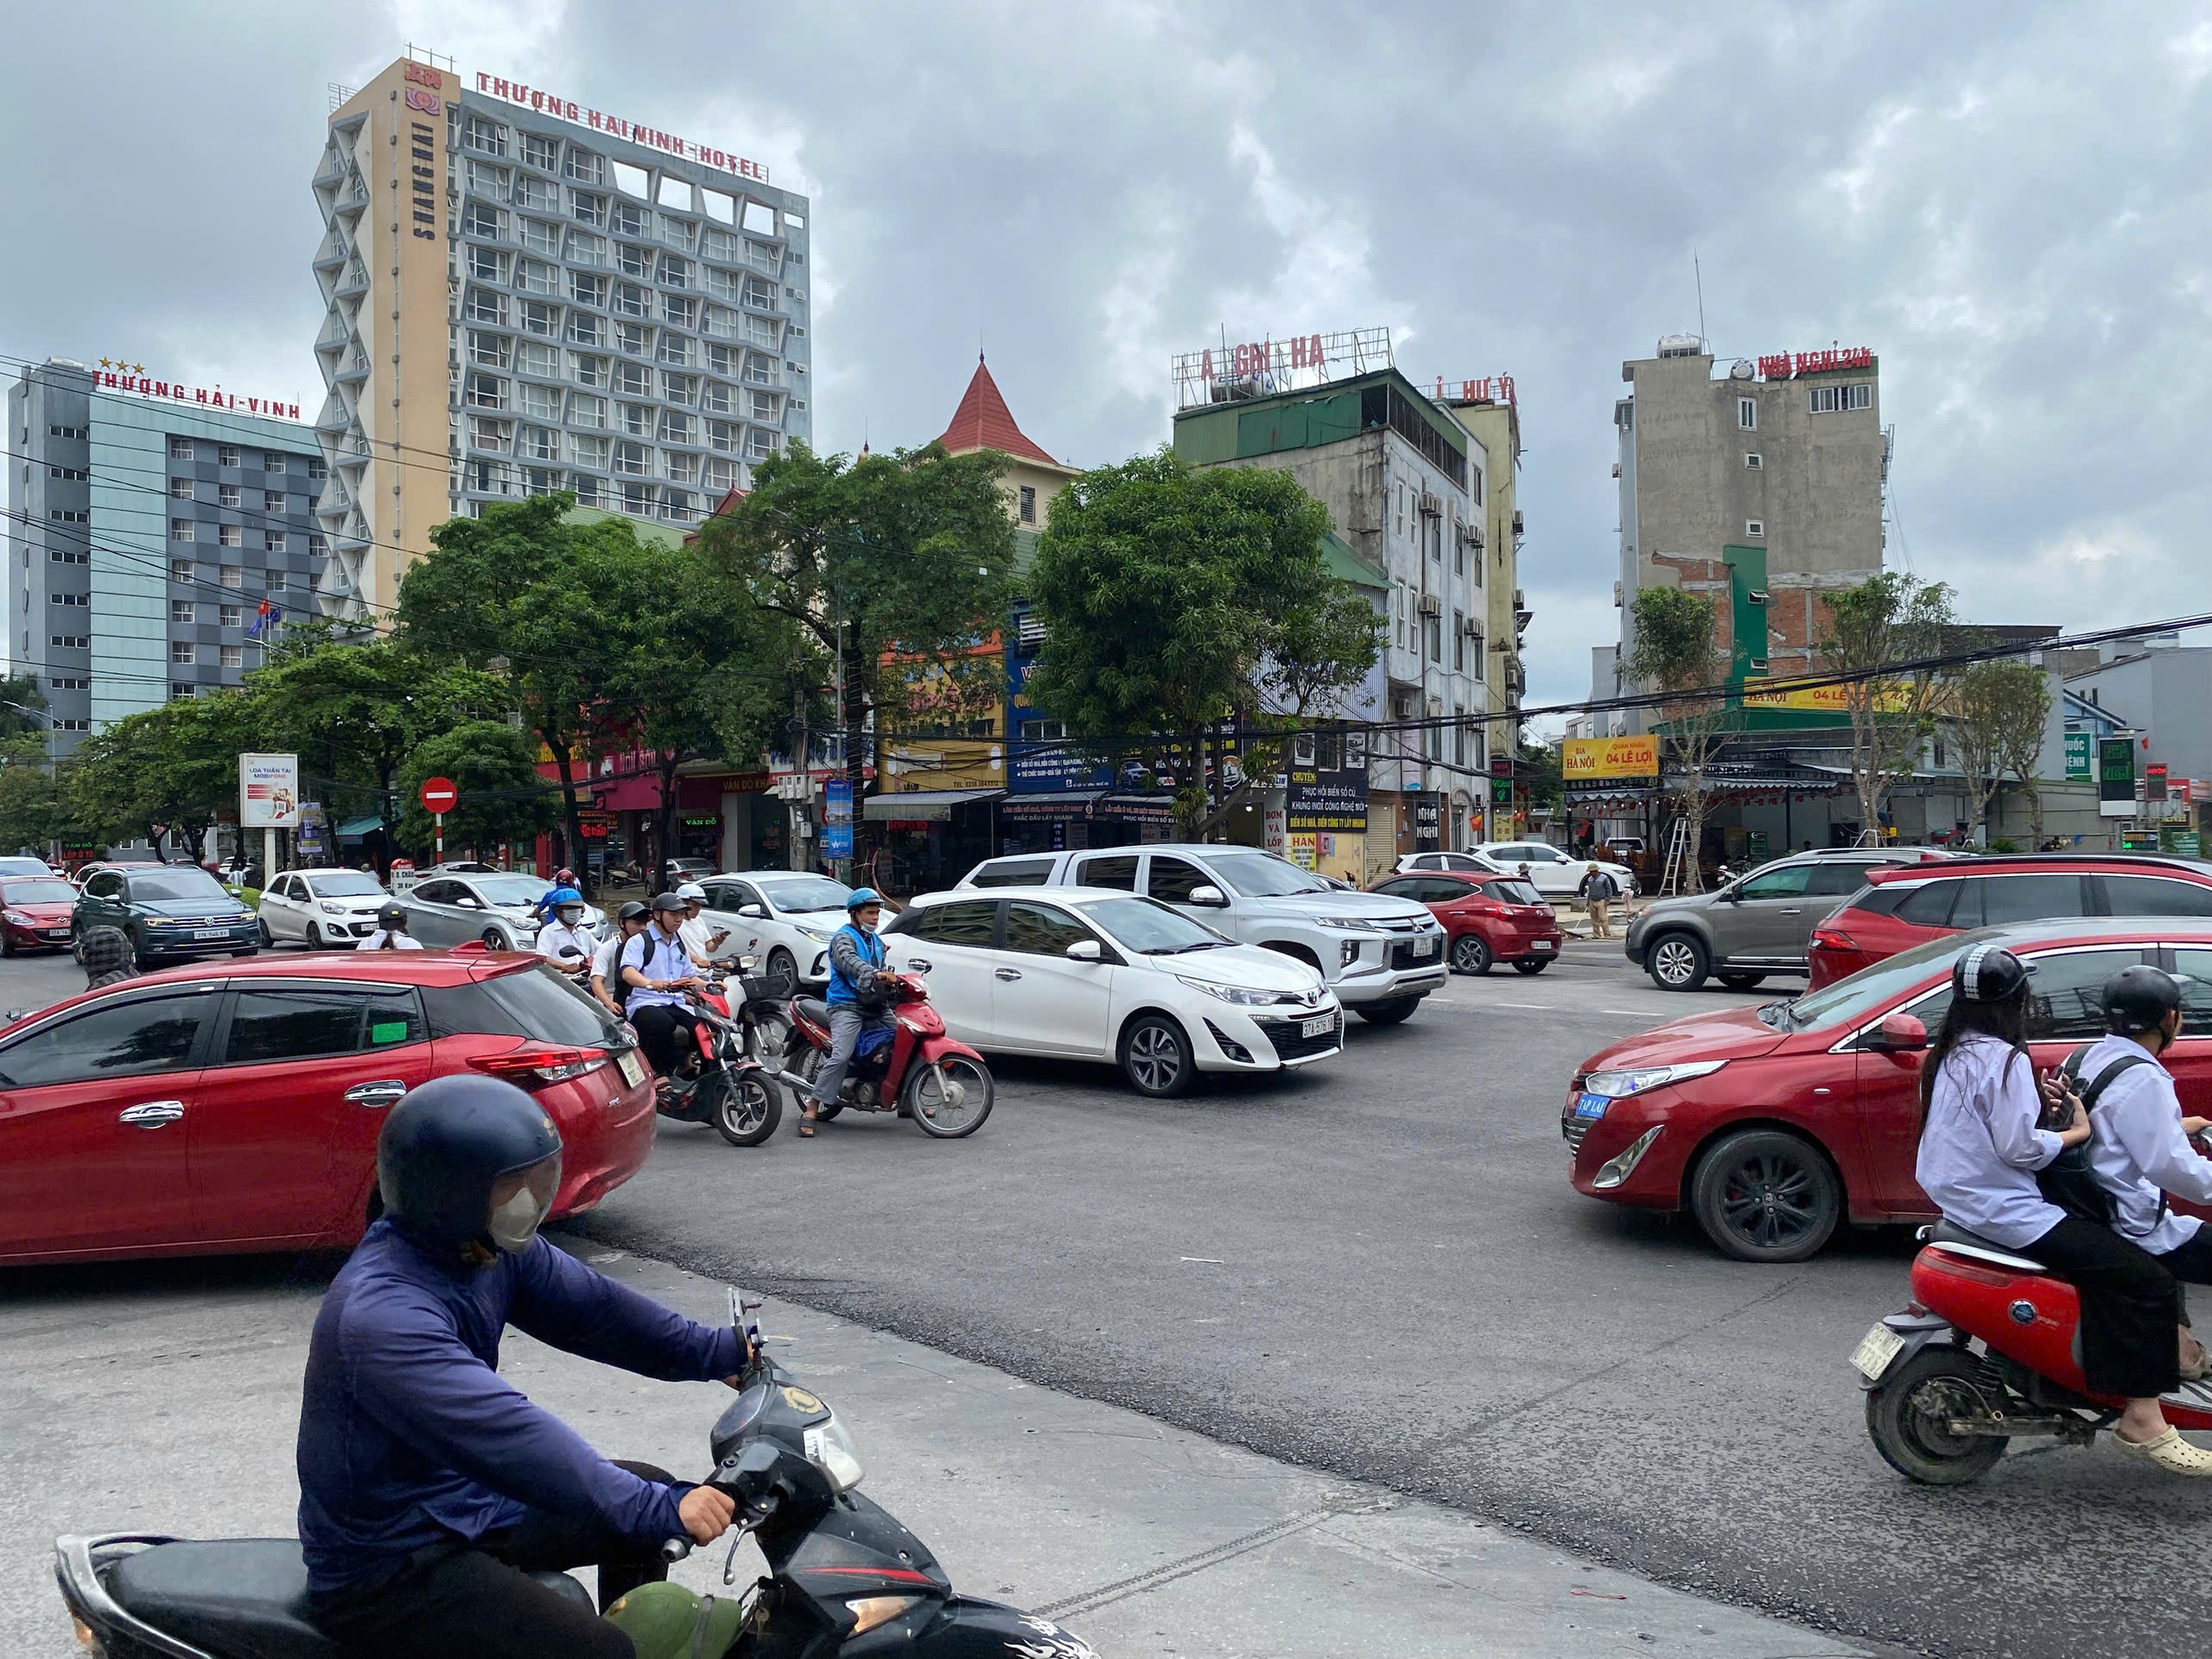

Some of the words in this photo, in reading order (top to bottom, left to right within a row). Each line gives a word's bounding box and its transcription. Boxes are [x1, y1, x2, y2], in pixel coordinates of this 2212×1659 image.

[634, 124, 683, 155] VINH
[701, 145, 763, 180] HOTEL
[411, 122, 435, 240] SHANGHAI
[1758, 350, 1793, 377] NHÀ
[92, 369, 186, 400] THƯỢNG
[1813, 690, 1829, 700] 04
[1567, 756, 1579, 768] HÀ
[1580, 755, 1595, 770] NỘI
[1606, 753, 1619, 764] 04
[1622, 750, 1633, 763] LÊ
[1637, 750, 1652, 765] LỢI
[1301, 786, 1317, 798] PHỤC
[1340, 785, 1348, 798] SỐ
[1292, 801, 1311, 810] KHUNG
[1311, 801, 1325, 810] INOX
[1325, 799, 1339, 811] CÔNG
[1417, 804, 1437, 822] NHÀ
[1268, 822, 1281, 832] VÁ
[1416, 820, 1439, 839] NGHỈ
[1267, 836, 1282, 847] LỐP
[1293, 834, 1315, 847] HÀN
